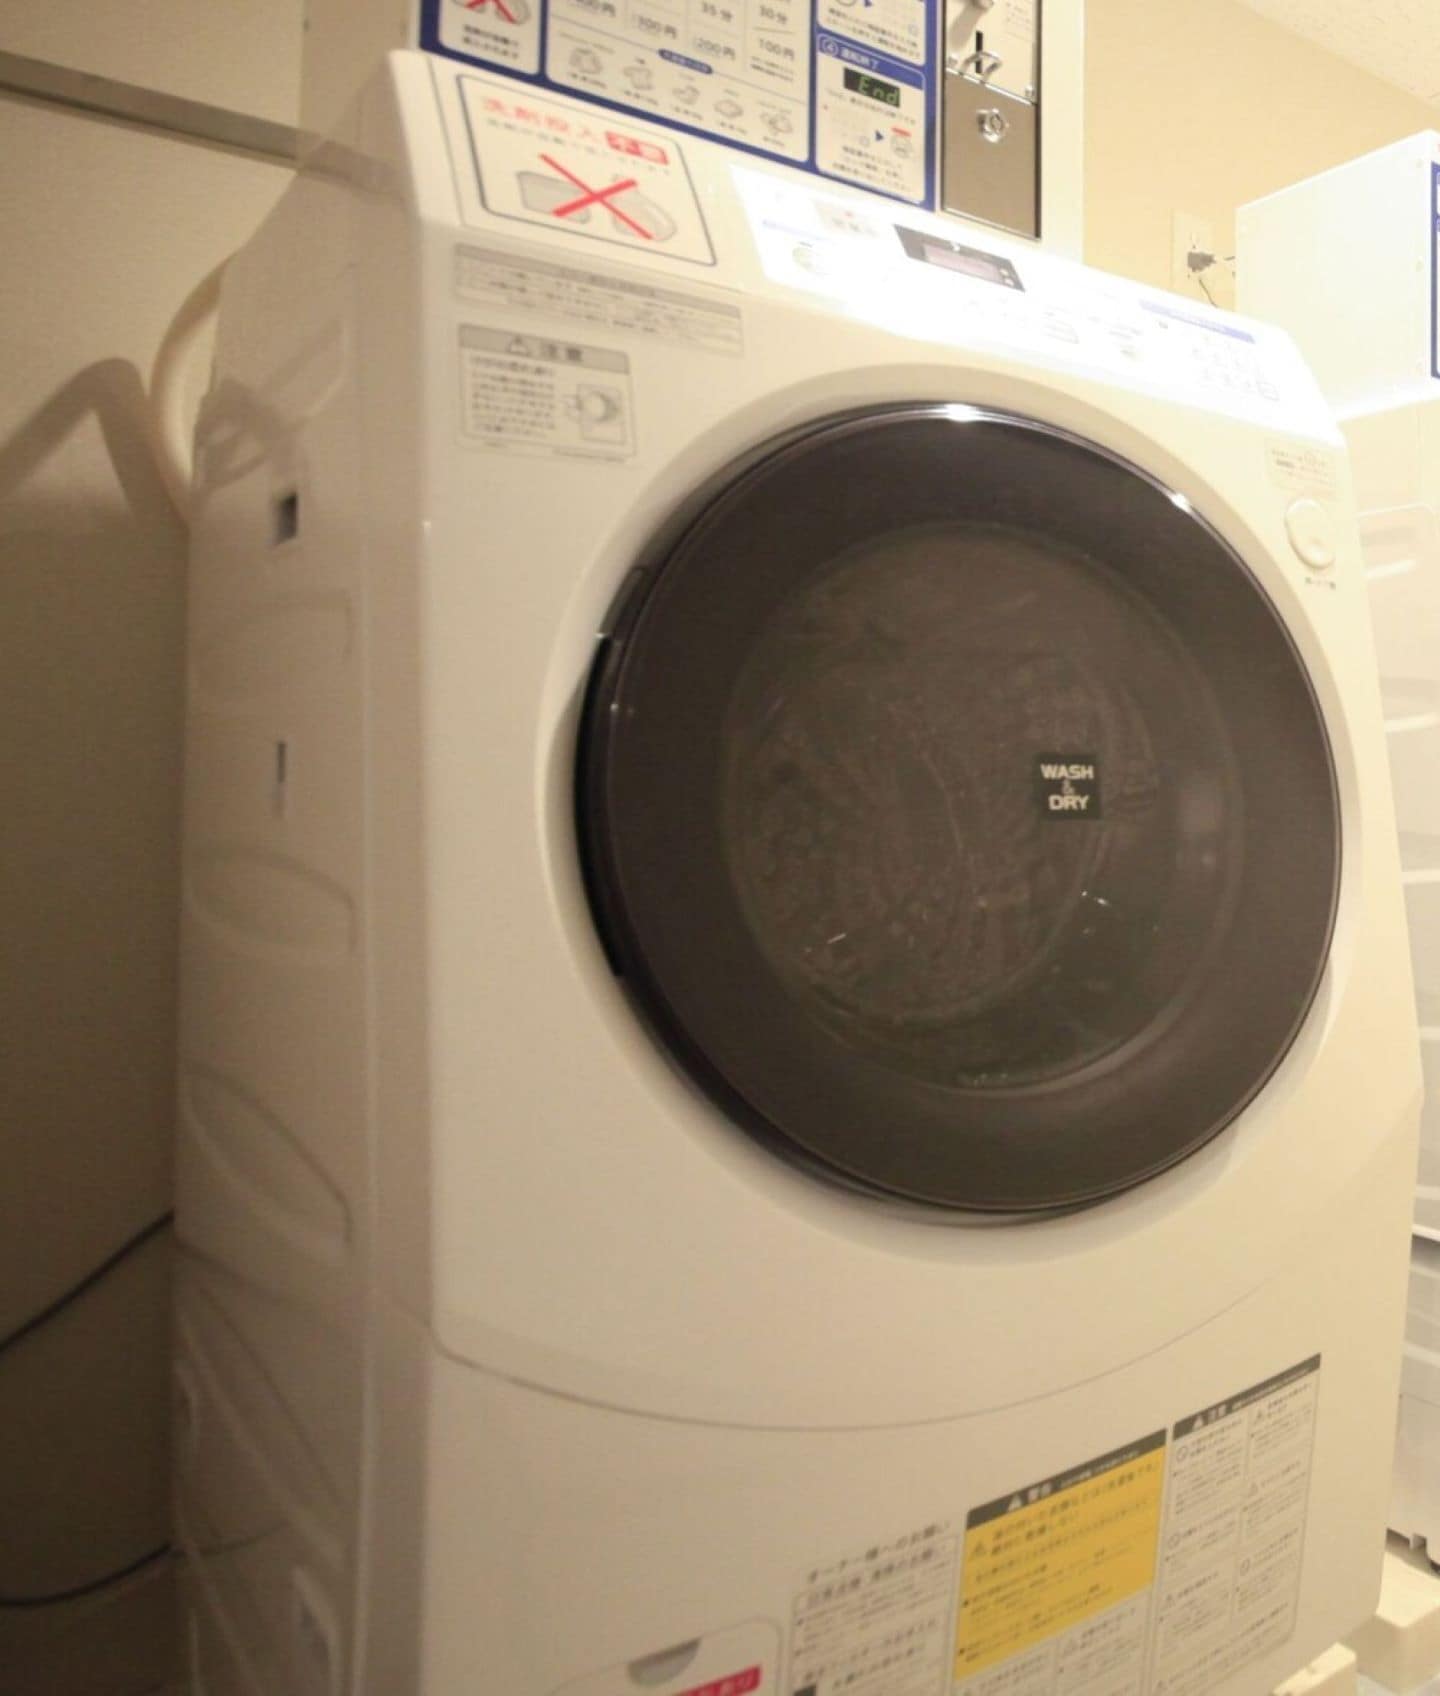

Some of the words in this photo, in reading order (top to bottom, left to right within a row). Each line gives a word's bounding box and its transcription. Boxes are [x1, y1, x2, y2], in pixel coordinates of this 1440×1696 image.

[858, 75, 900, 106] End
[1040, 763, 1094, 779] WASH
[1048, 794, 1090, 810] DRY
